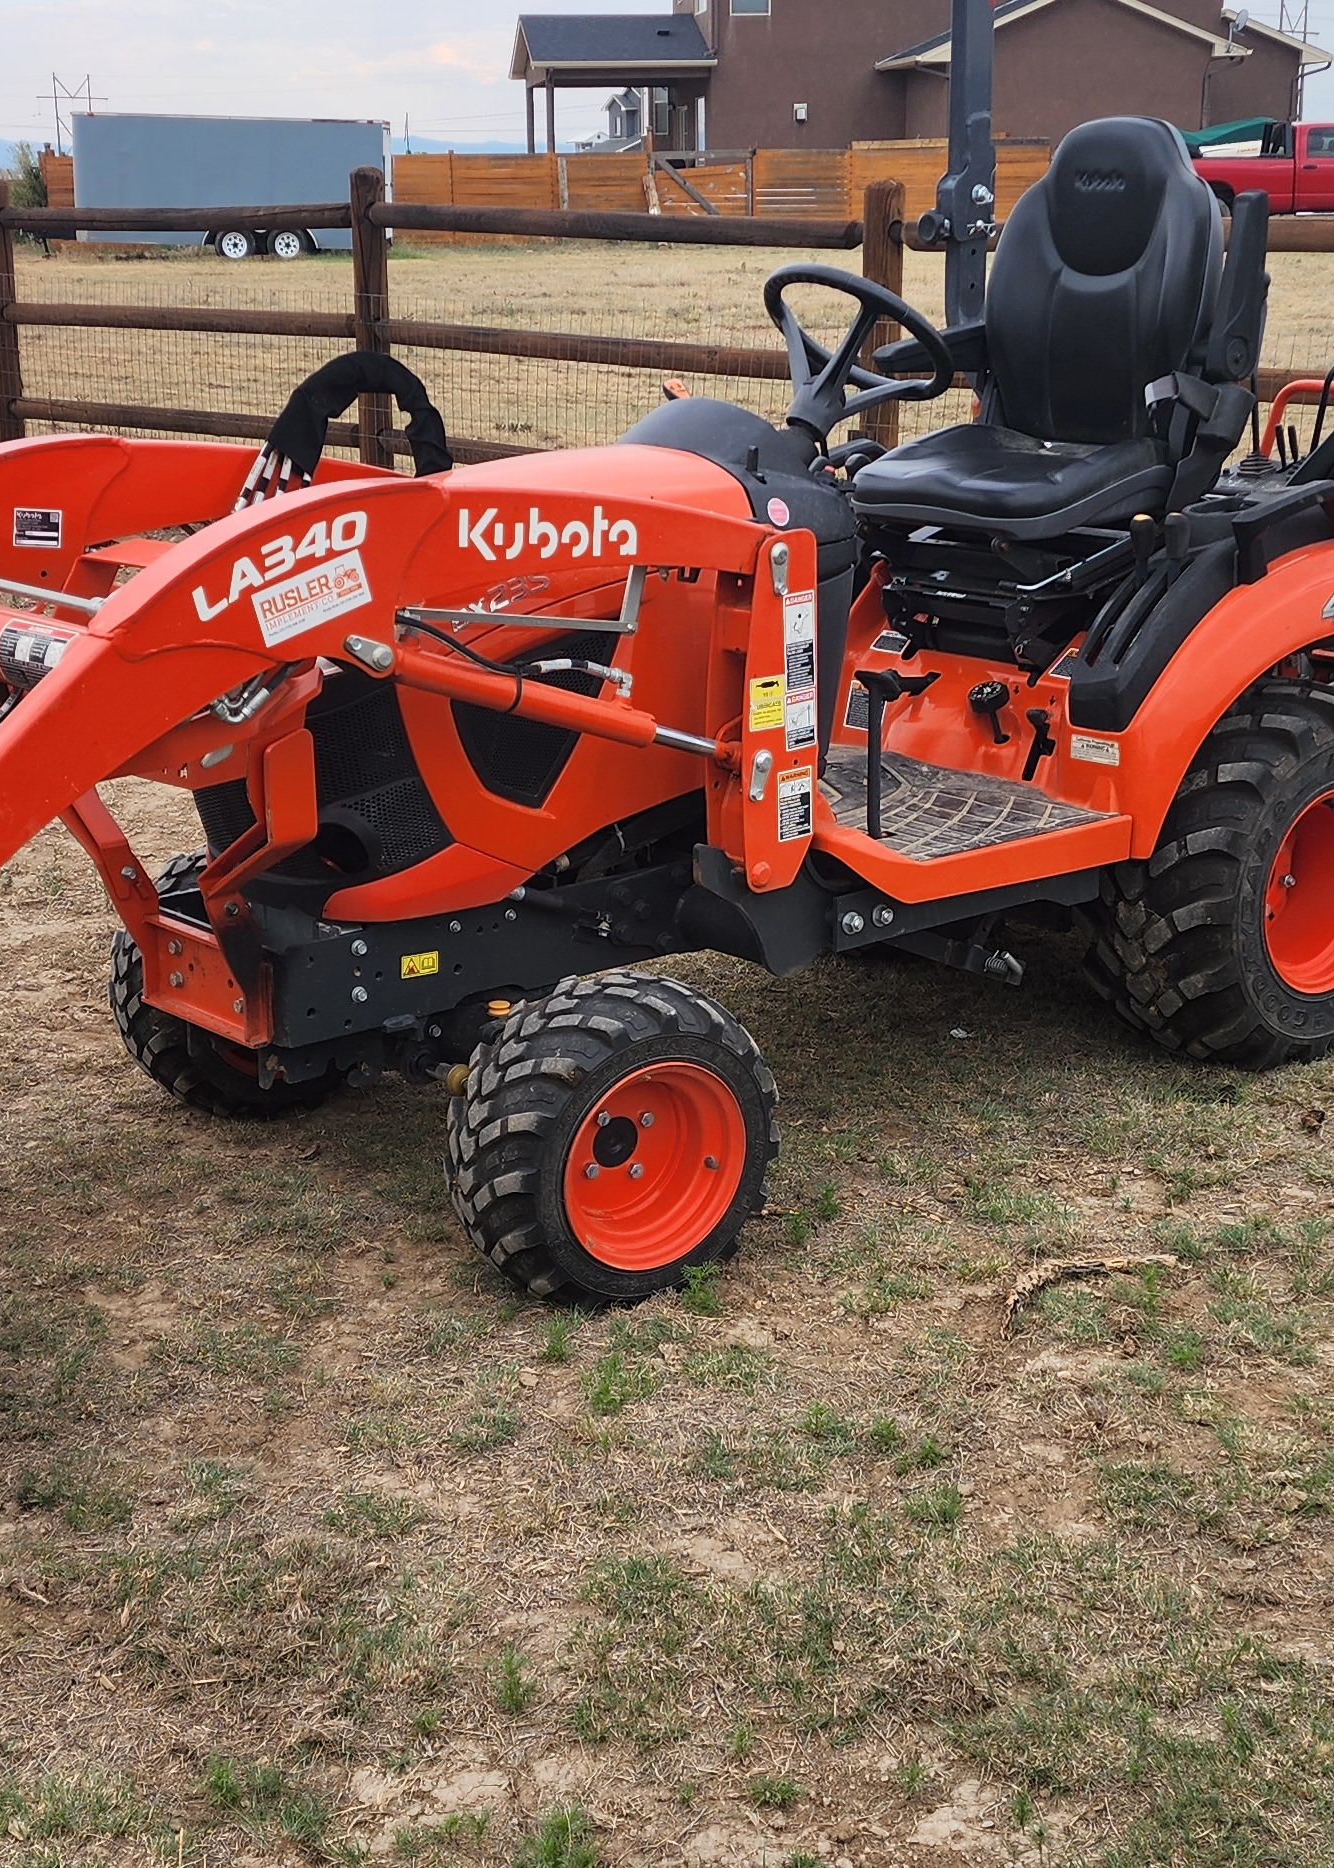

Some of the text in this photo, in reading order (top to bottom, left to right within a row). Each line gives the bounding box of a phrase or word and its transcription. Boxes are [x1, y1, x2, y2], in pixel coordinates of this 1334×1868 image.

[458, 506, 638, 561] Kubota
[191, 511, 368, 622] LA340
[258, 573, 332, 620] RUSLER
[264, 602, 319, 632] IMPLEMENT
